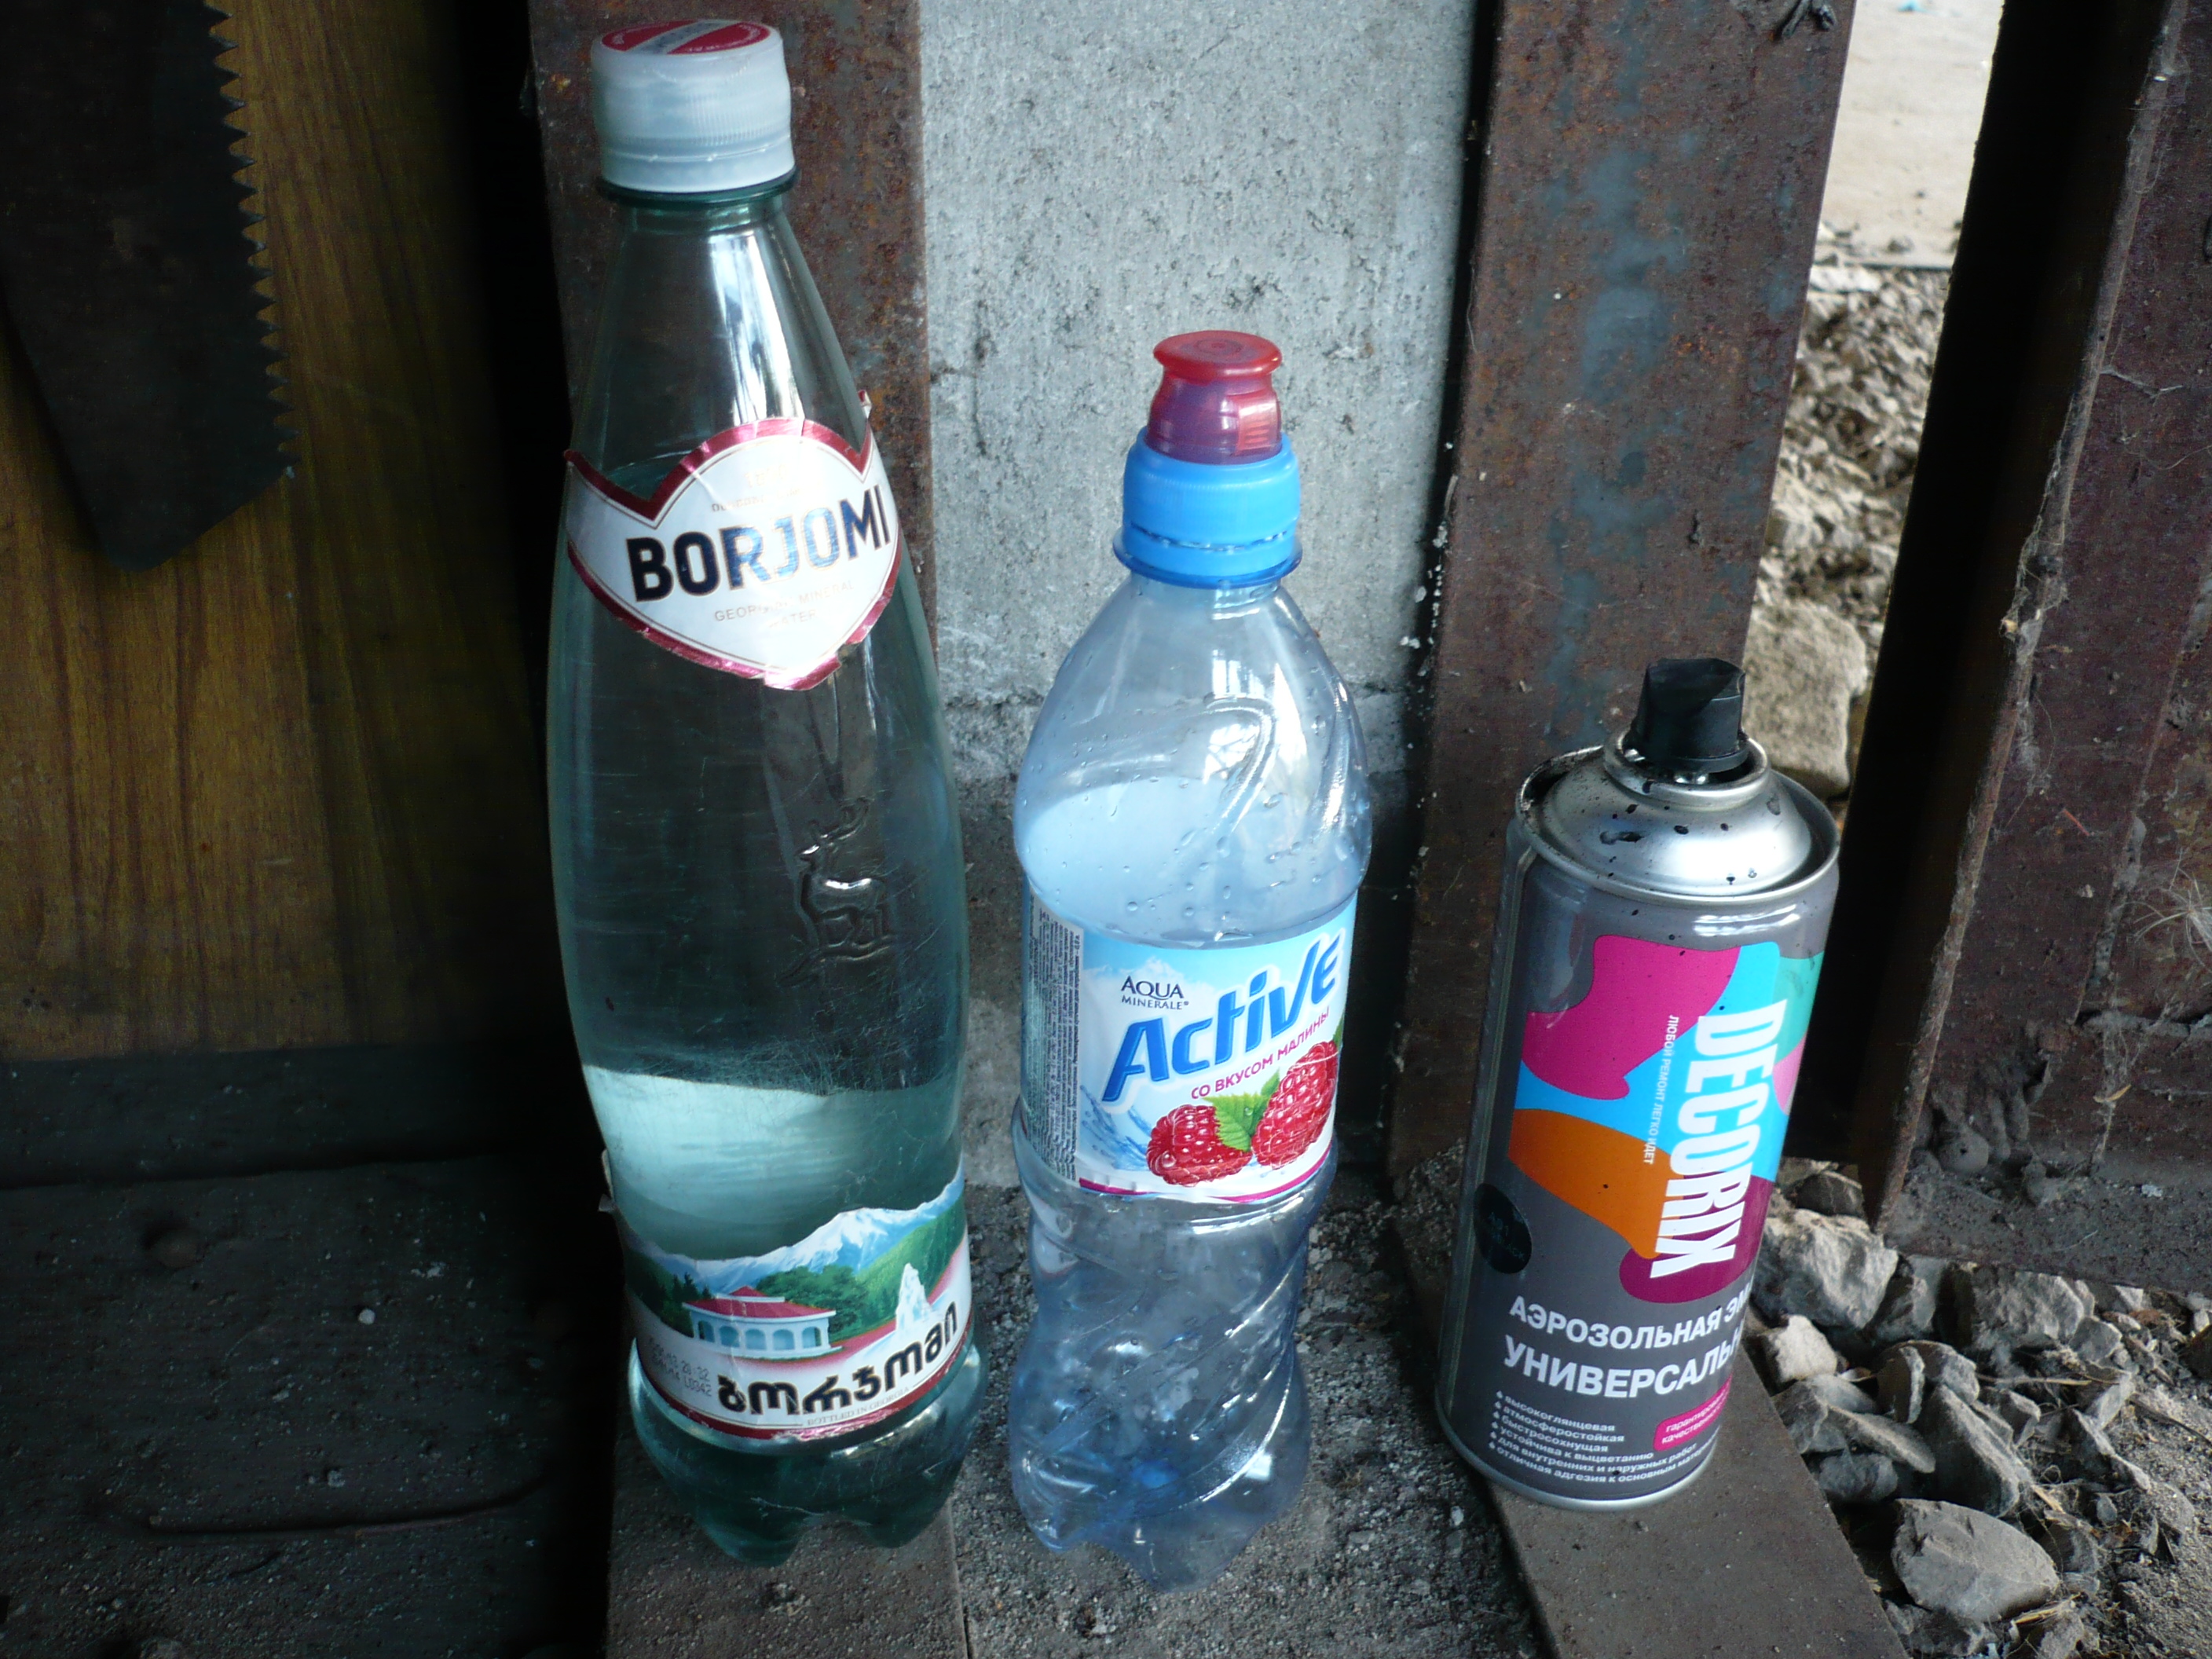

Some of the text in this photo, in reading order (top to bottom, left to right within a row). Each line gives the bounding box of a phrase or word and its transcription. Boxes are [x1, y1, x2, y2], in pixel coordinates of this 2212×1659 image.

[626, 484, 892, 603] BORJOMI
[798, 580, 855, 605] MINERAL
[1120, 975, 1185, 1001] AQUA
[1191, 1005, 1330, 1100] СО ВКУСОМ МАЛИНЫ
[1663, 1014, 1679, 1057] ЛЮБОЙ
[1654, 1058, 1672, 1102] РЕМОНТ
[1649, 1102, 1664, 1137] ЛЕГКО
[1649, 998, 1788, 1279] DECORIX
[1509, 1295, 1723, 1350] АЭРОЗОЛЬНАЯ
[1503, 1318, 1745, 1398] УНИВЕРСАЛЬН
[807, 1386, 910, 1426] BOTTLED IN GEORGIA
[1497, 1437, 1520, 1452] для
[1573, 1452, 1654, 1463] выцветанию
